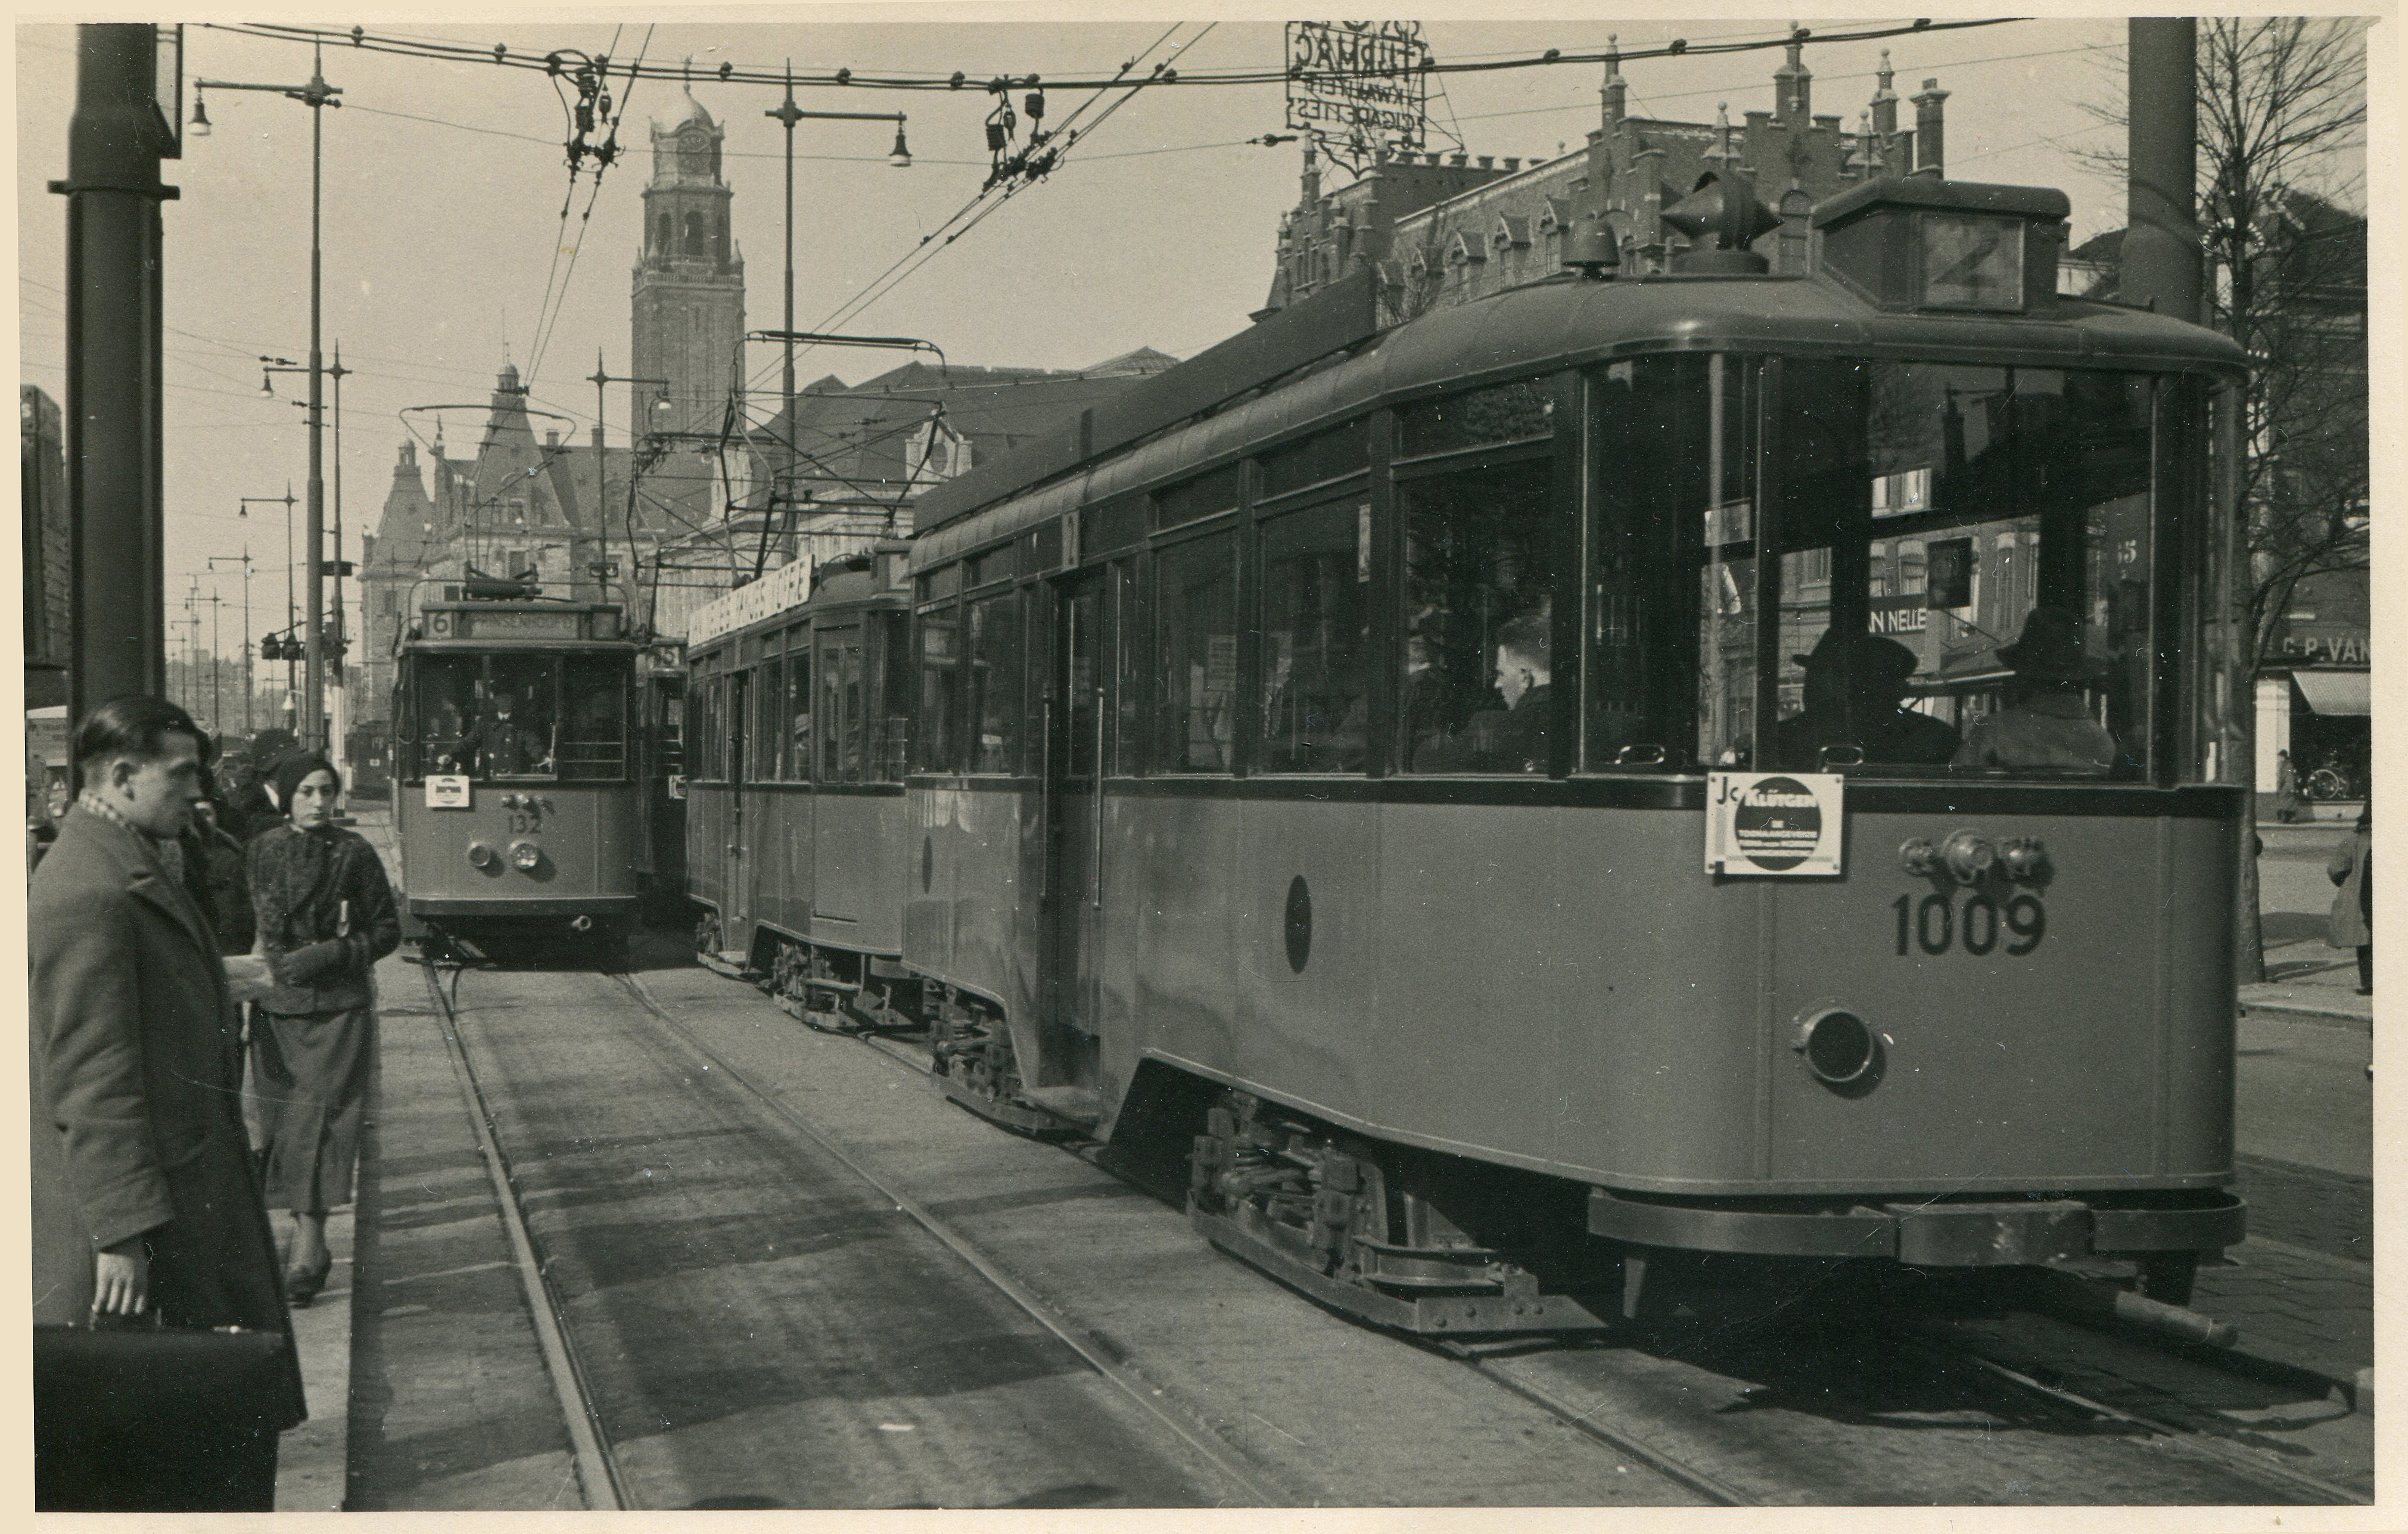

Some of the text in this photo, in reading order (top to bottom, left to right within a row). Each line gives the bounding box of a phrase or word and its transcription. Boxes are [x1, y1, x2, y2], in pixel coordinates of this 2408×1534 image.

[433, 612, 449, 633] 6
[1888, 608, 1927, 632] NELLE
[508, 814, 542, 834] 132
[1891, 894, 2046, 956] 1009
